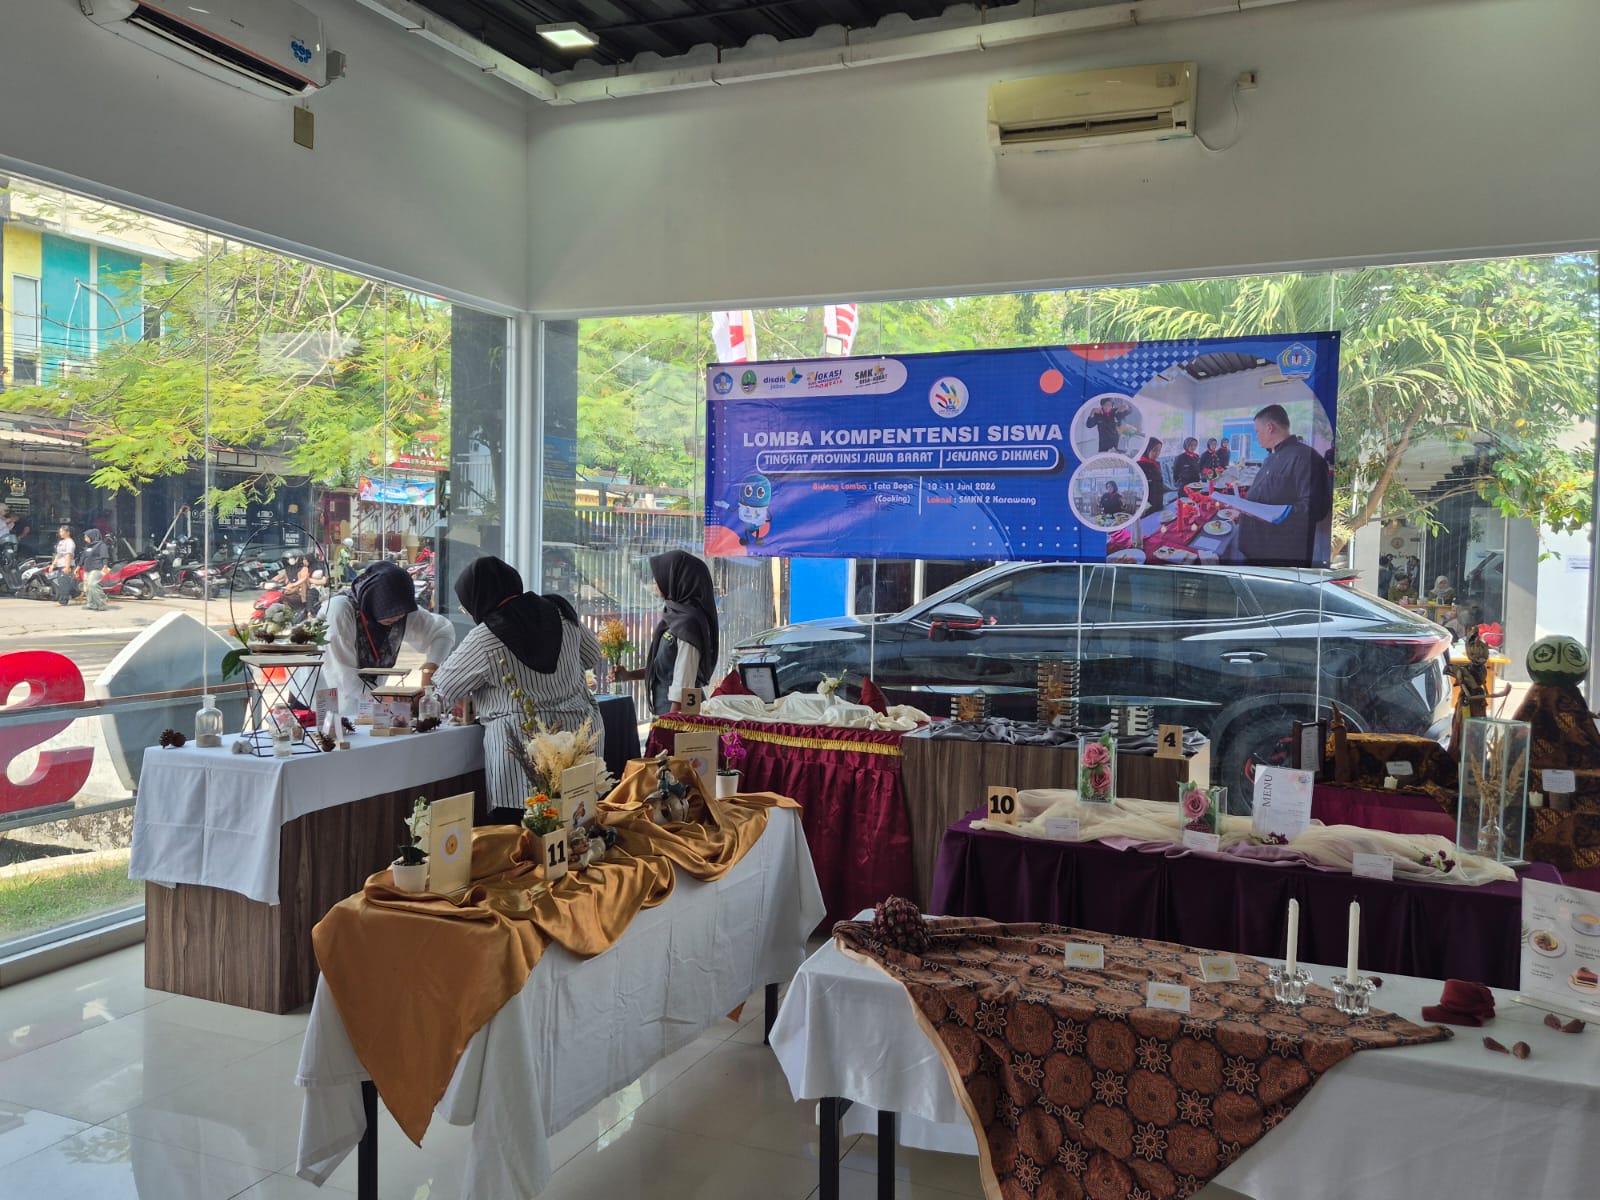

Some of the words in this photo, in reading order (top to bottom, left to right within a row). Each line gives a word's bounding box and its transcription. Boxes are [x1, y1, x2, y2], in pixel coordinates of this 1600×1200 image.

[854, 368, 874, 380] SMK
[743, 431, 814, 447] LOMBA
[820, 426, 980, 445] KOMPENTENSI
[987, 424, 1063, 442] SISWA
[764, 453, 809, 465] TINGKAT
[811, 452, 861, 465] PROVINSI
[863, 452, 894, 463] JAWA
[897, 451, 933, 463] BARAT
[945, 450, 998, 462] JENJANG
[1001, 449, 1049, 461] DIKMEN
[841, 482, 867, 490] Lomba
[873, 482, 891, 490] Tata
[945, 482, 954, 490] 11
[957, 482, 973, 490] Juni
[975, 482, 996, 490] 2026
[874, 494, 911, 504] (Cooking)
[959, 495, 983, 504] SMKN
[985, 495, 991, 503] 2
[993, 495, 1037, 505] Karawang
[686, 693, 696, 706] 3
[1163, 732, 1176, 748] 4
[1262, 774, 1273, 808] MENU
[989, 795, 1015, 814] 10
[547, 840, 566, 867] 11
